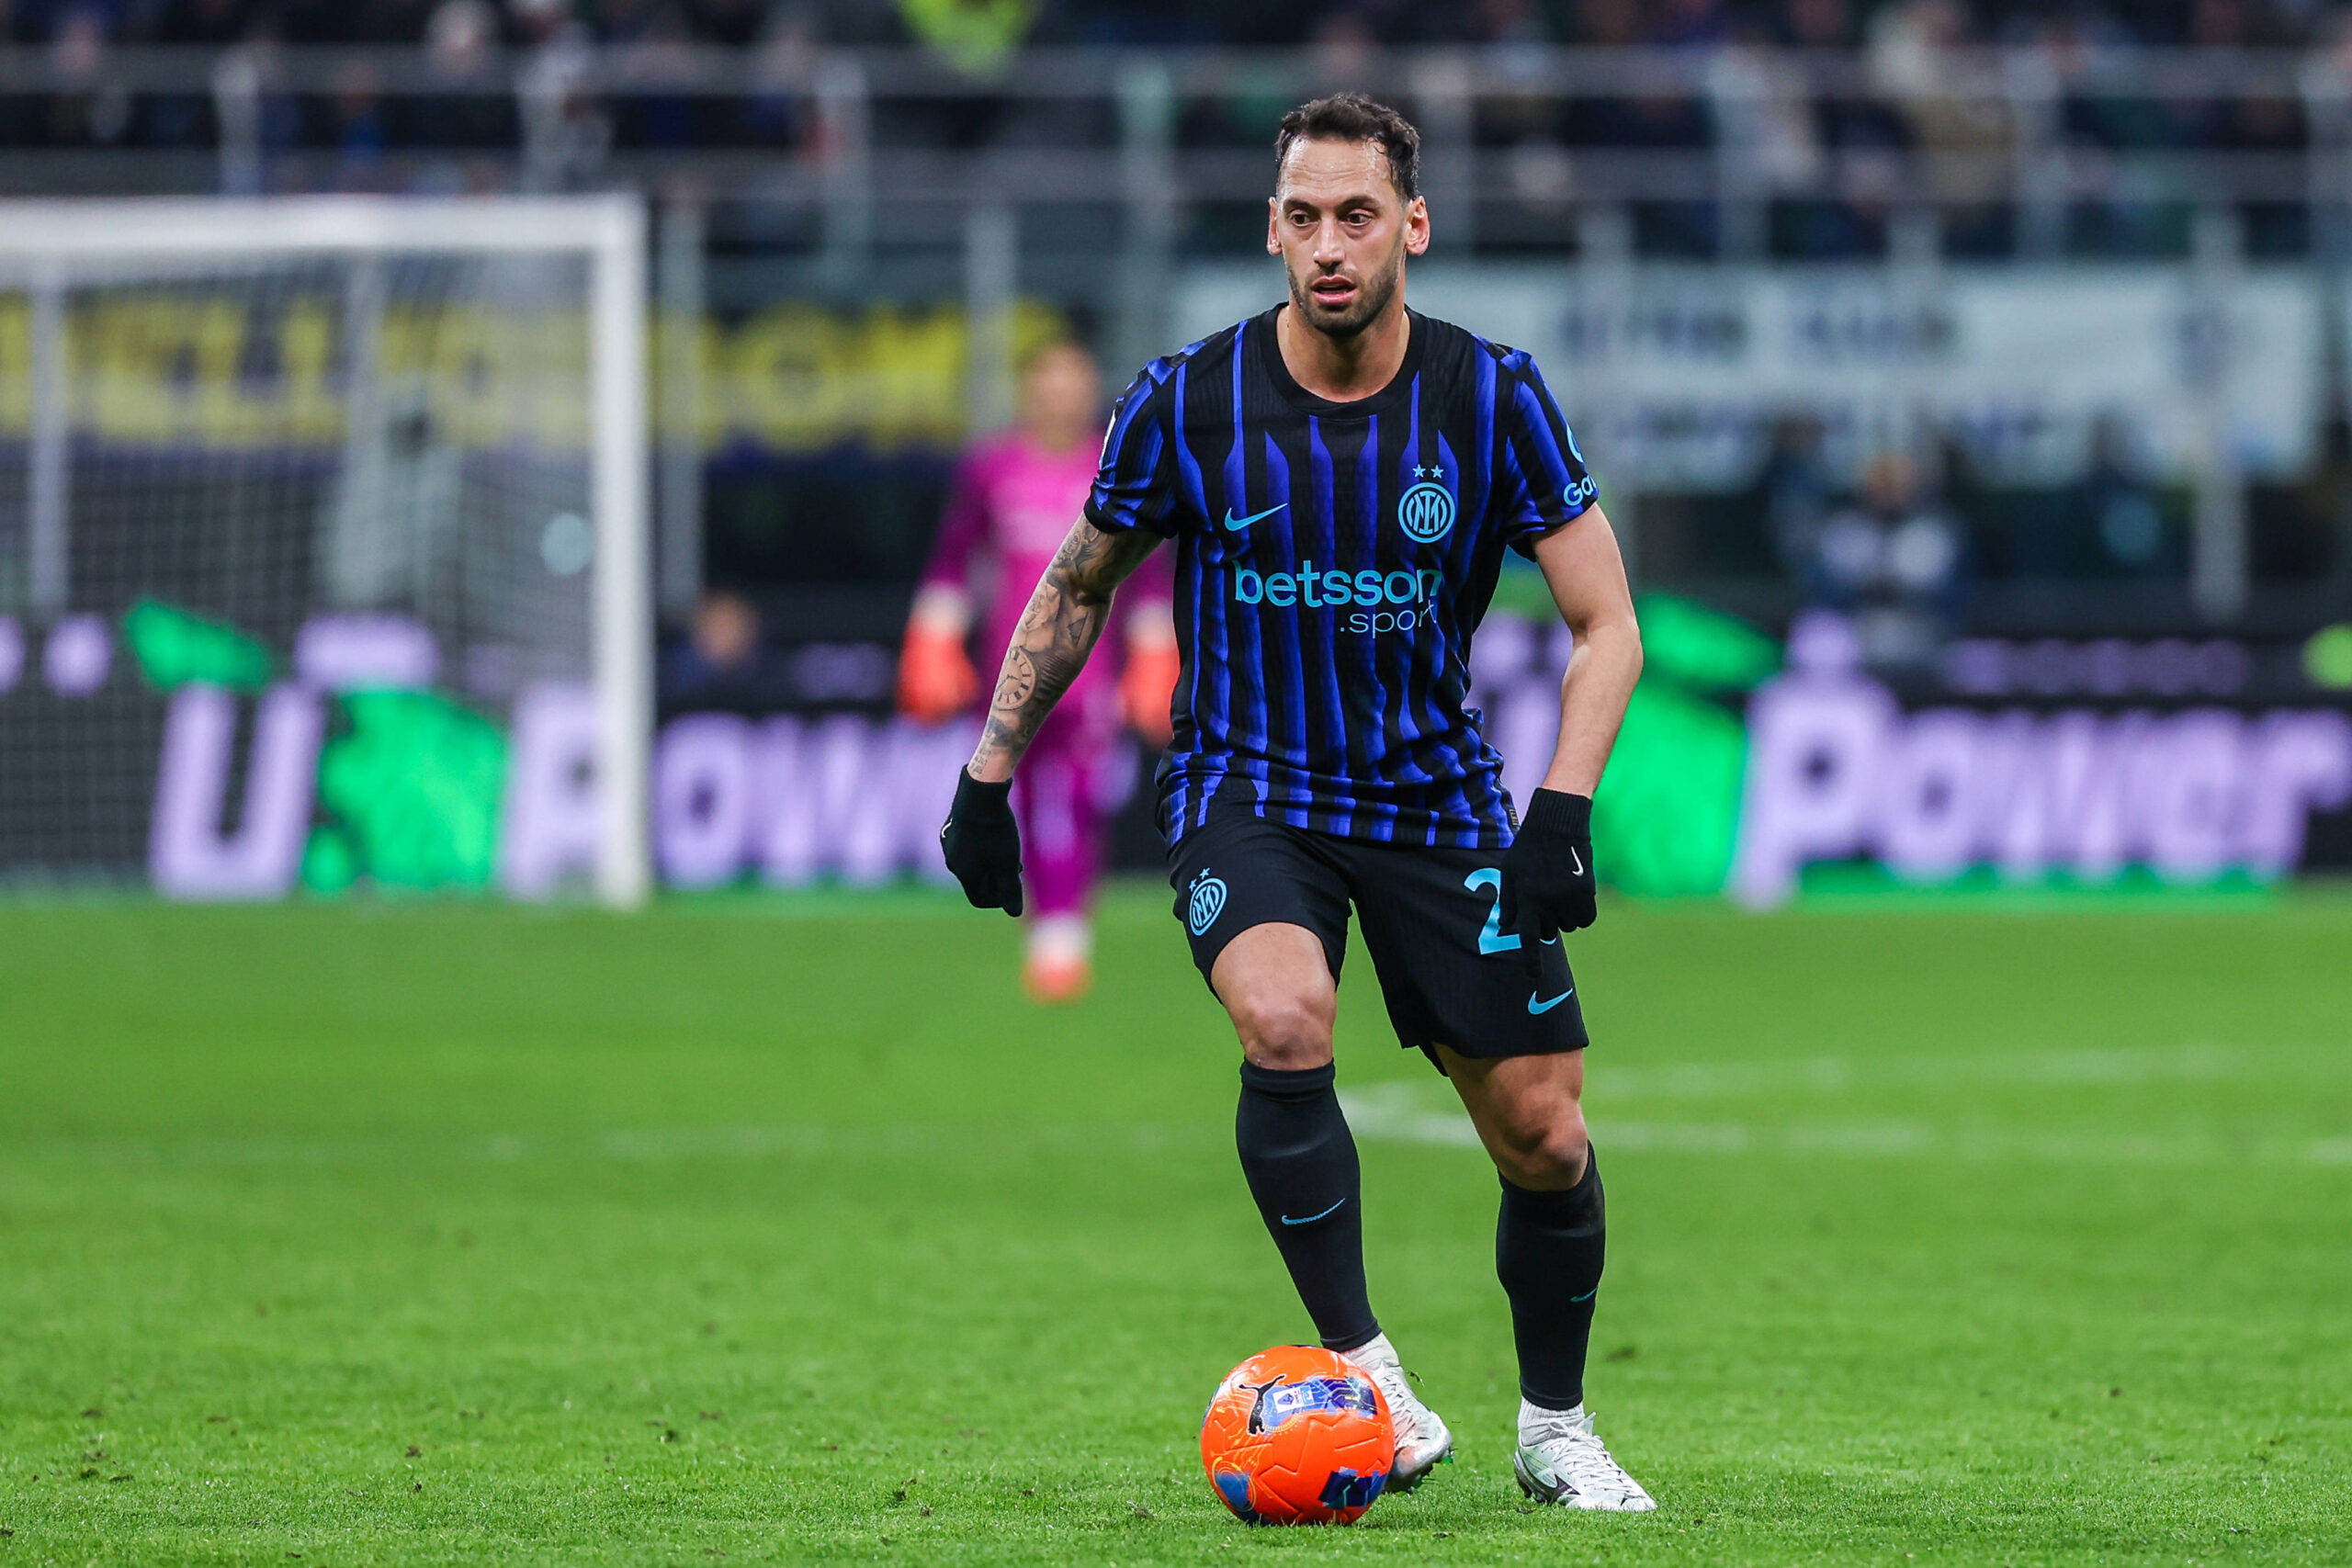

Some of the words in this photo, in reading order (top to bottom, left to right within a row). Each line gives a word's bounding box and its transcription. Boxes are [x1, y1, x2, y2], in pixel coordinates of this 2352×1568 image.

[1563, 475, 1597, 506] Ga
[1232, 559, 1442, 608] betsson
[1340, 599, 1438, 639] .sport
